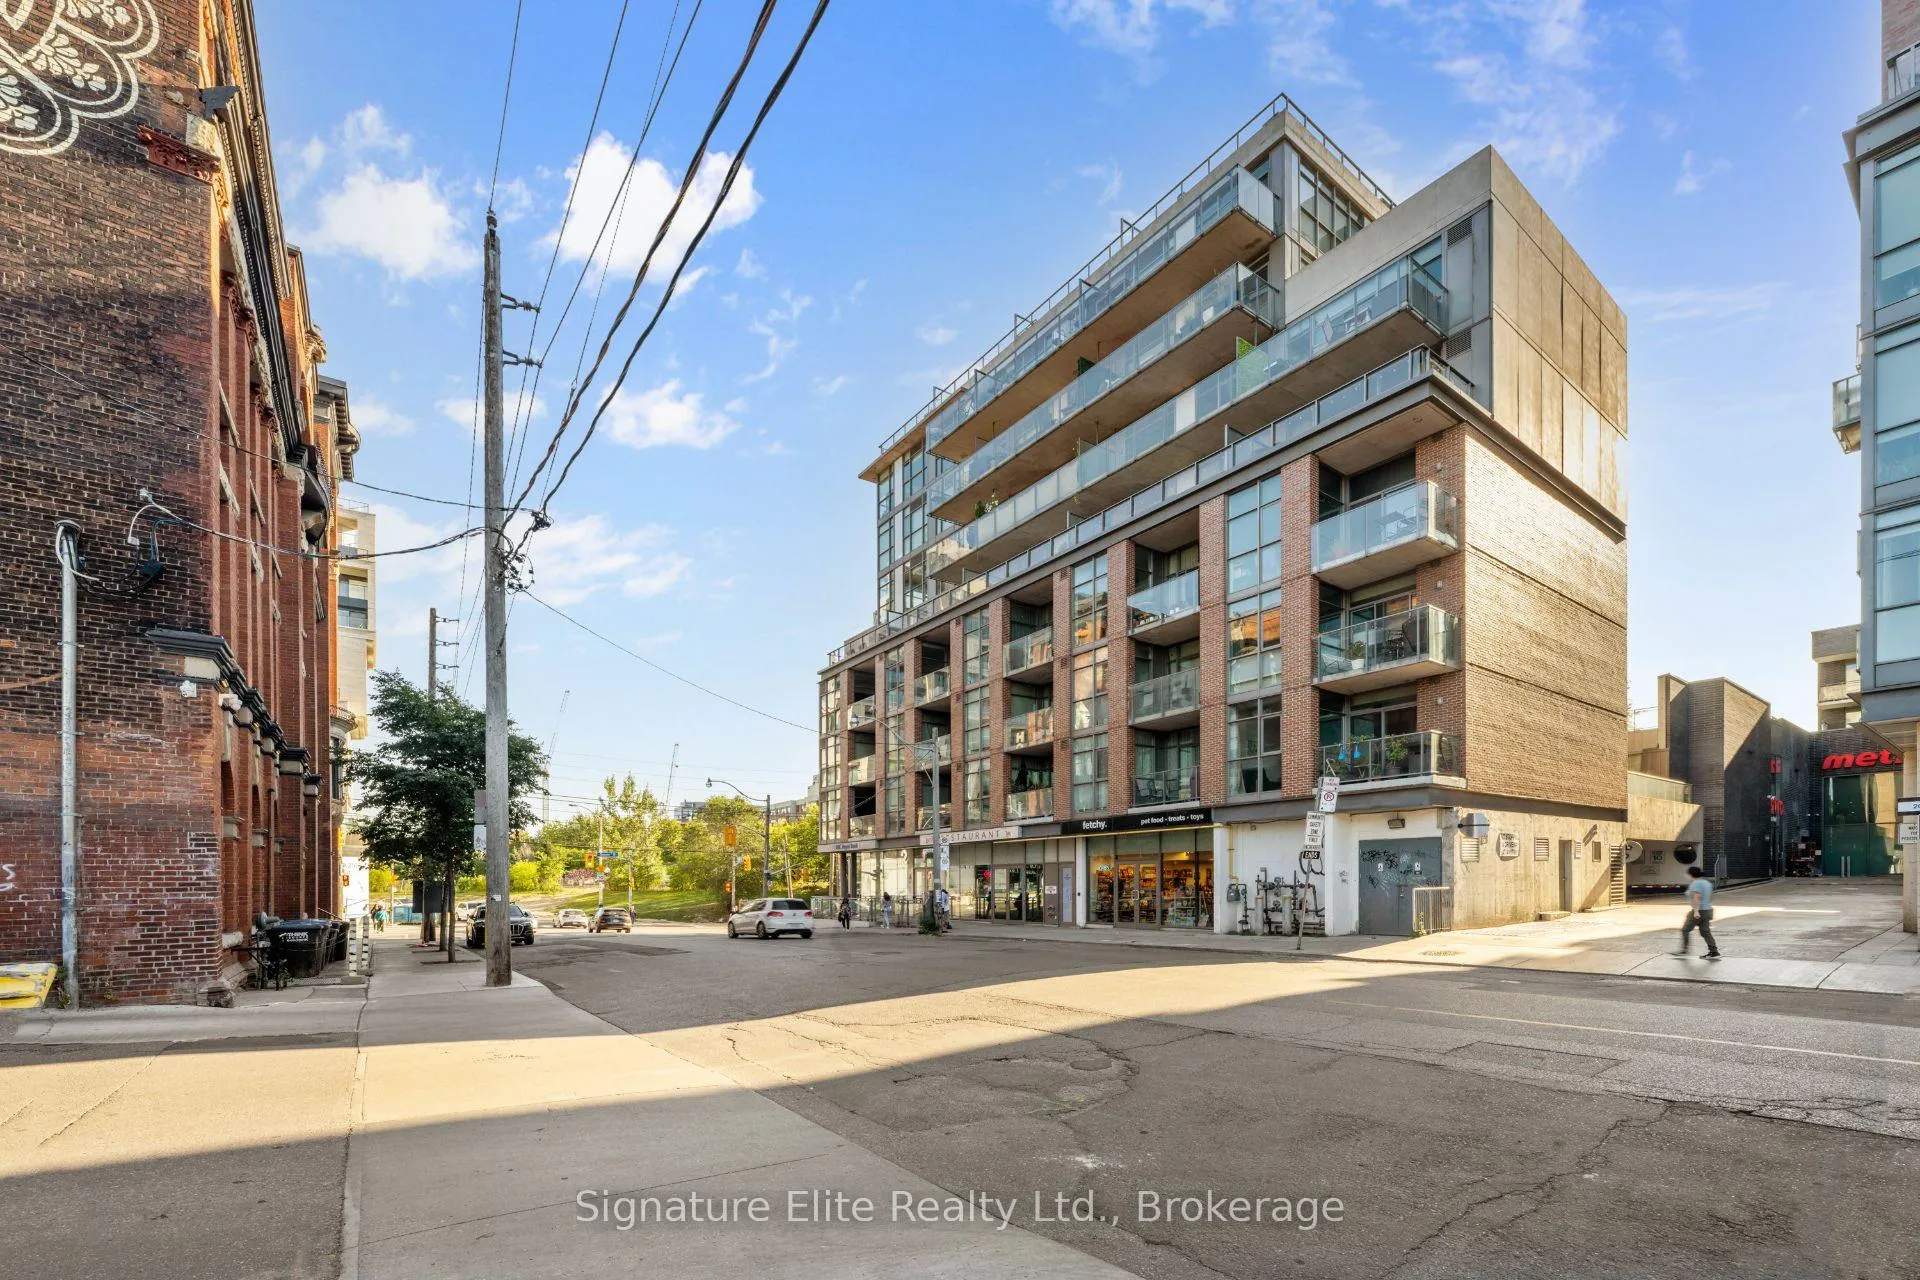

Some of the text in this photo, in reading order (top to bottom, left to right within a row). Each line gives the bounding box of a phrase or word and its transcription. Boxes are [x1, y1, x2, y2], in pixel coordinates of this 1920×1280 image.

[1821, 749, 1904, 770] met
[1082, 820, 1108, 830] fetchy.
[1140, 818, 1150, 826] pet
[1150, 816, 1164, 824] food
[1168, 814, 1186, 822] treats
[1190, 813, 1204, 821] toys
[1304, 851, 1318, 859] ENDS
